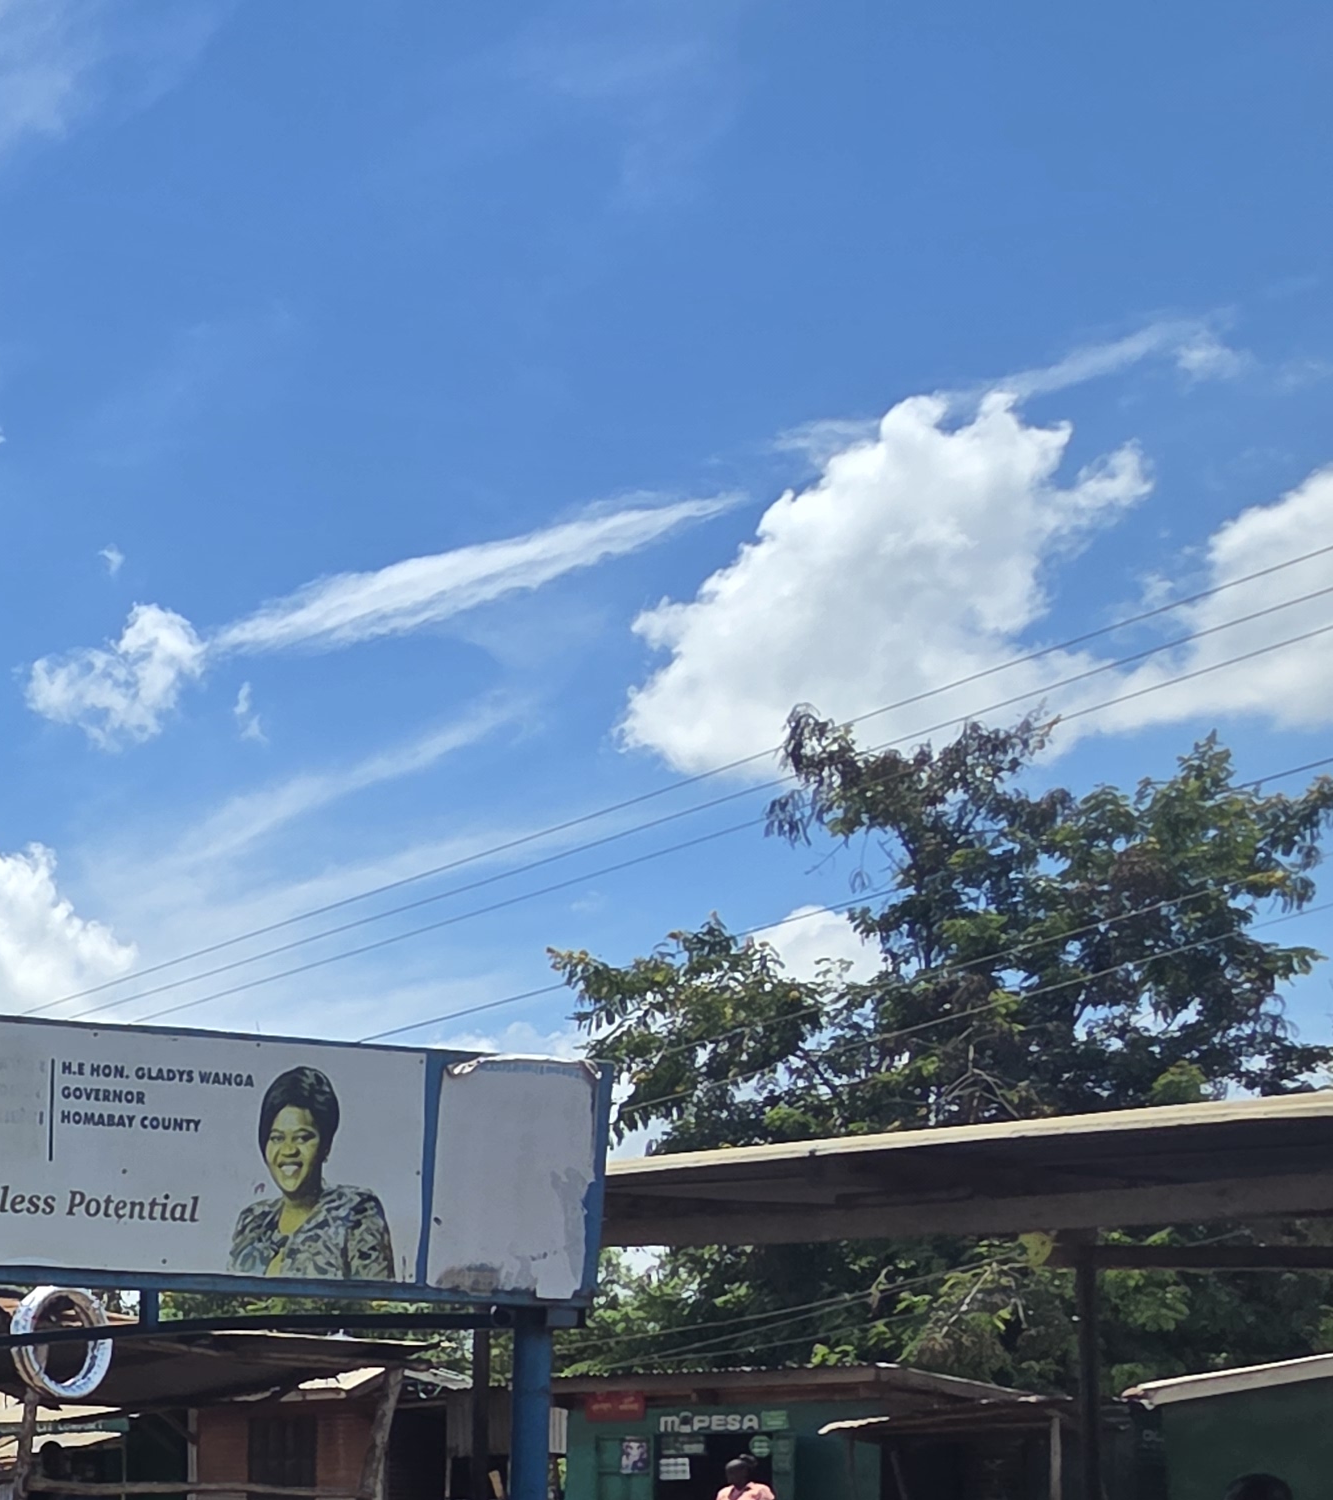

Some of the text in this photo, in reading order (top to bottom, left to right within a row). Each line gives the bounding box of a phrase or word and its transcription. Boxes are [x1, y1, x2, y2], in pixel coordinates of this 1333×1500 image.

[90, 1063, 130, 1079] HON.
[135, 1067, 194, 1084] GLADYS
[198, 1070, 255, 1088] WANGA
[61, 1086, 146, 1105] GOVERNOR
[60, 1110, 136, 1129] HOMABAY
[140, 1115, 202, 1133] COUNTY
[65, 1189, 200, 1223] Potential
